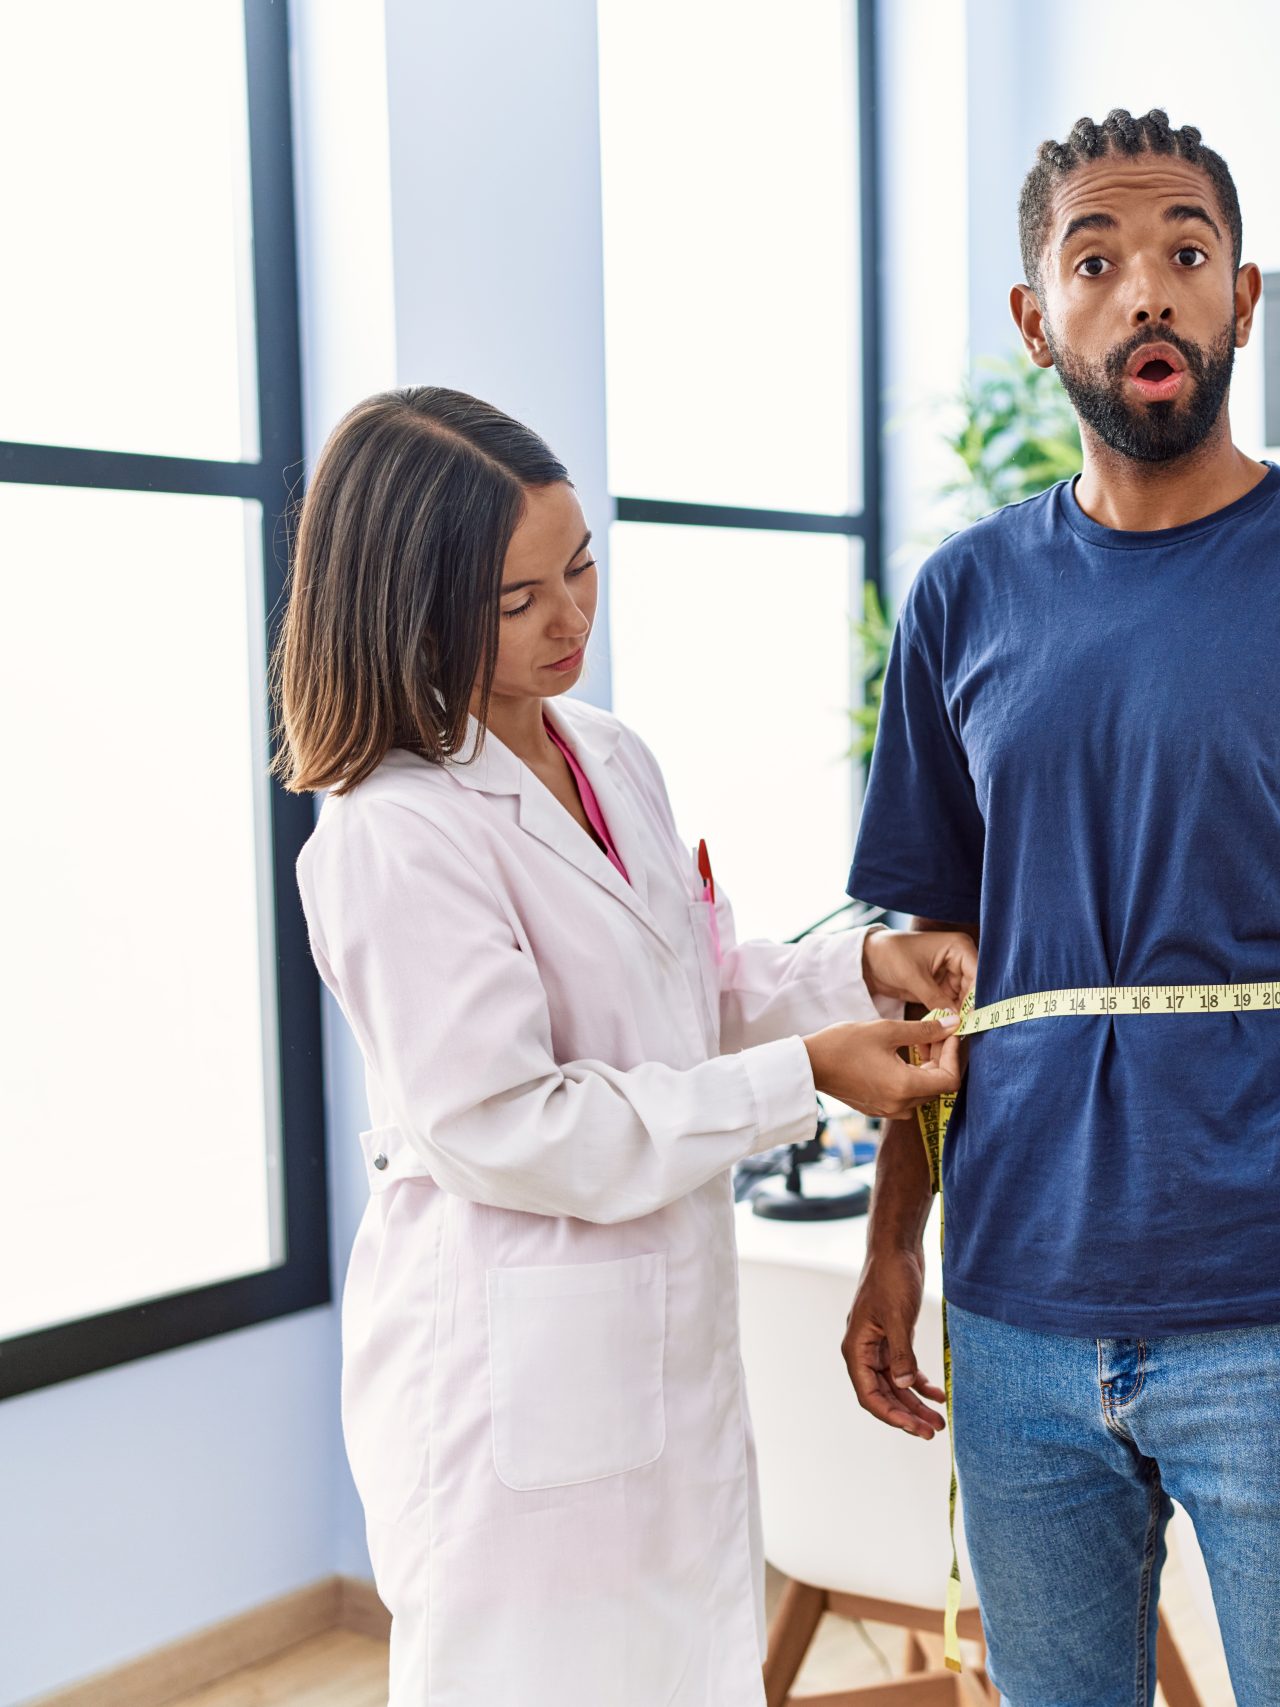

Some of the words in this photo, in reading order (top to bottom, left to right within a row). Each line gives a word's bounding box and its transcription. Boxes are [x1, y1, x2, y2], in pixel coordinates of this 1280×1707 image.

[989, 1011, 1000, 1025] 10
[1005, 1007, 1015, 1021] 11
[1023, 1003, 1034, 1017] 12
[1043, 999, 1057, 1013] 13
[1069, 997, 1086, 1011] 14
[1099, 997, 1117, 1010] 15
[1132, 996, 1151, 1009] 16
[1166, 995, 1185, 1009] 17
[1200, 994, 1219, 1008] 18
[1233, 993, 1251, 1007] 19
